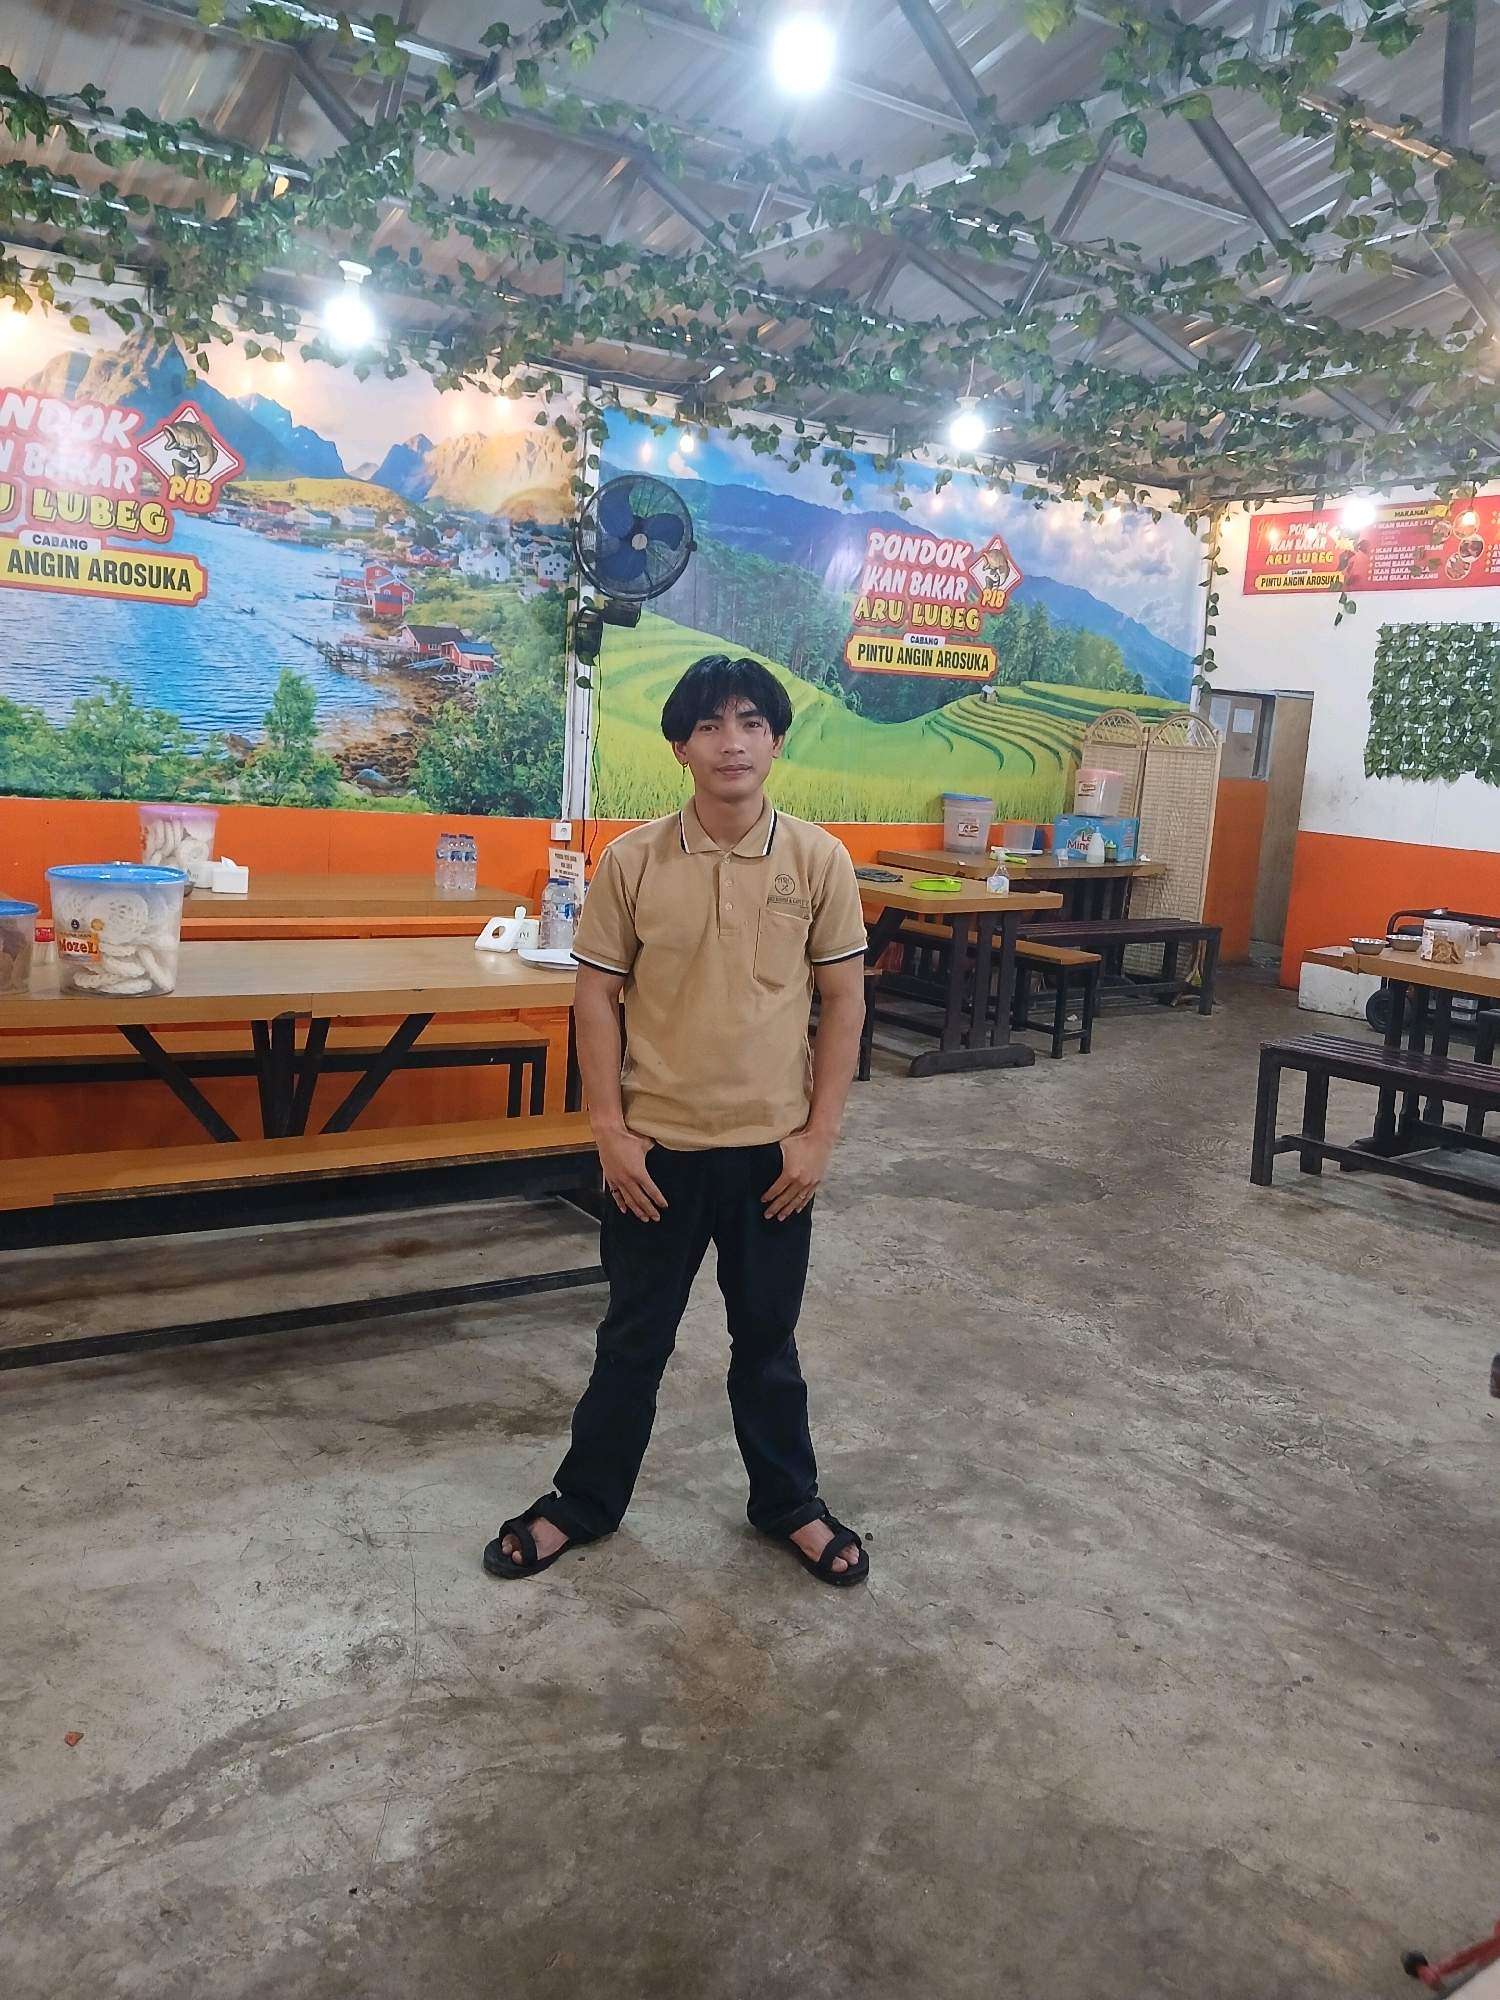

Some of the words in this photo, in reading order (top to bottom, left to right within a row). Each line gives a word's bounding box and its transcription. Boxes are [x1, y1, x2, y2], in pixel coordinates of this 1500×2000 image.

[23, 443, 138, 494] BAKAR
[169, 477, 213, 506] PIB
[32, 488, 169, 537] LUBEG
[32, 534, 88, 551] CABANG
[1288, 522, 1329, 537] PONOK
[868, 532, 971, 572] PONDOK
[1266, 553, 1291, 566] ARU
[1295, 551, 1334, 565] LUBEG
[1270, 539, 1293, 552] IKAN
[1295, 537, 1327, 551] BAKAR
[7, 549, 80, 580] ANGIN
[88, 557, 191, 593] AROSUKA
[862, 565, 907, 594] IKAN
[909, 571, 968, 603] BAKAR
[1261, 577, 1281, 587] PINTU
[1283, 576, 1304, 587] ANGIN
[1306, 575, 1340, 586] AROSUKA
[981, 588, 1005, 609] PIB
[855, 597, 904, 623] ARU
[911, 603, 980, 633] LUBEG
[910, 636, 939, 646] CABANG
[857, 643, 893, 663] PINTU
[897, 648, 932, 667] ANGIN
[936, 651, 989, 671] AROSUKA
